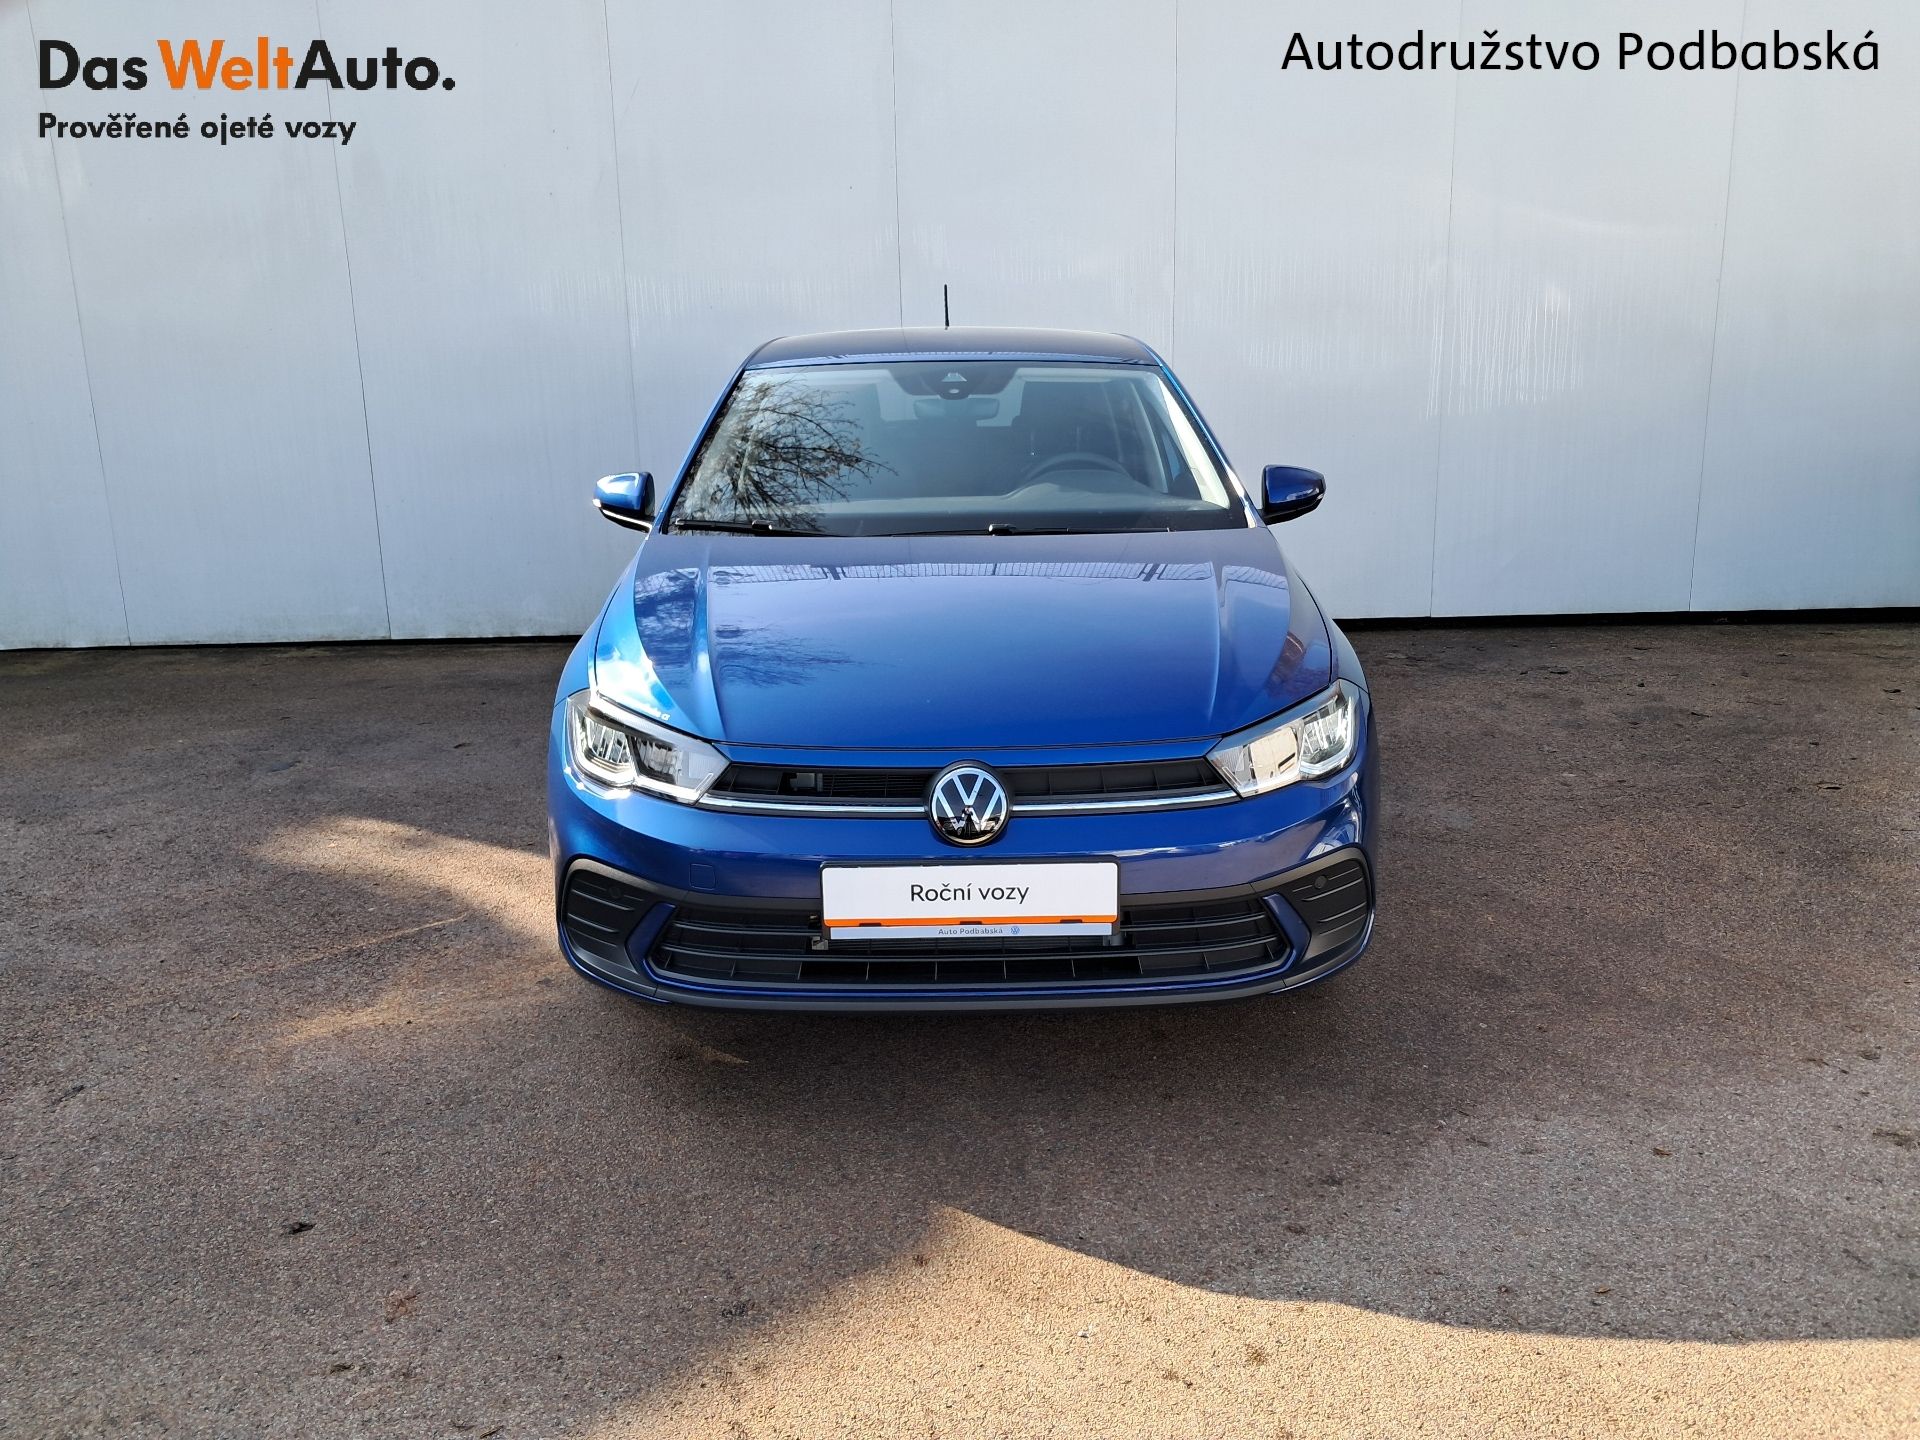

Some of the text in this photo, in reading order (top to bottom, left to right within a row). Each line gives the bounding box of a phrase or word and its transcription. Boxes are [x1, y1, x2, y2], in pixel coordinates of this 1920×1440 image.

[934, 768, 1005, 840] VW
[910, 883, 1030, 905] Roční vozy
